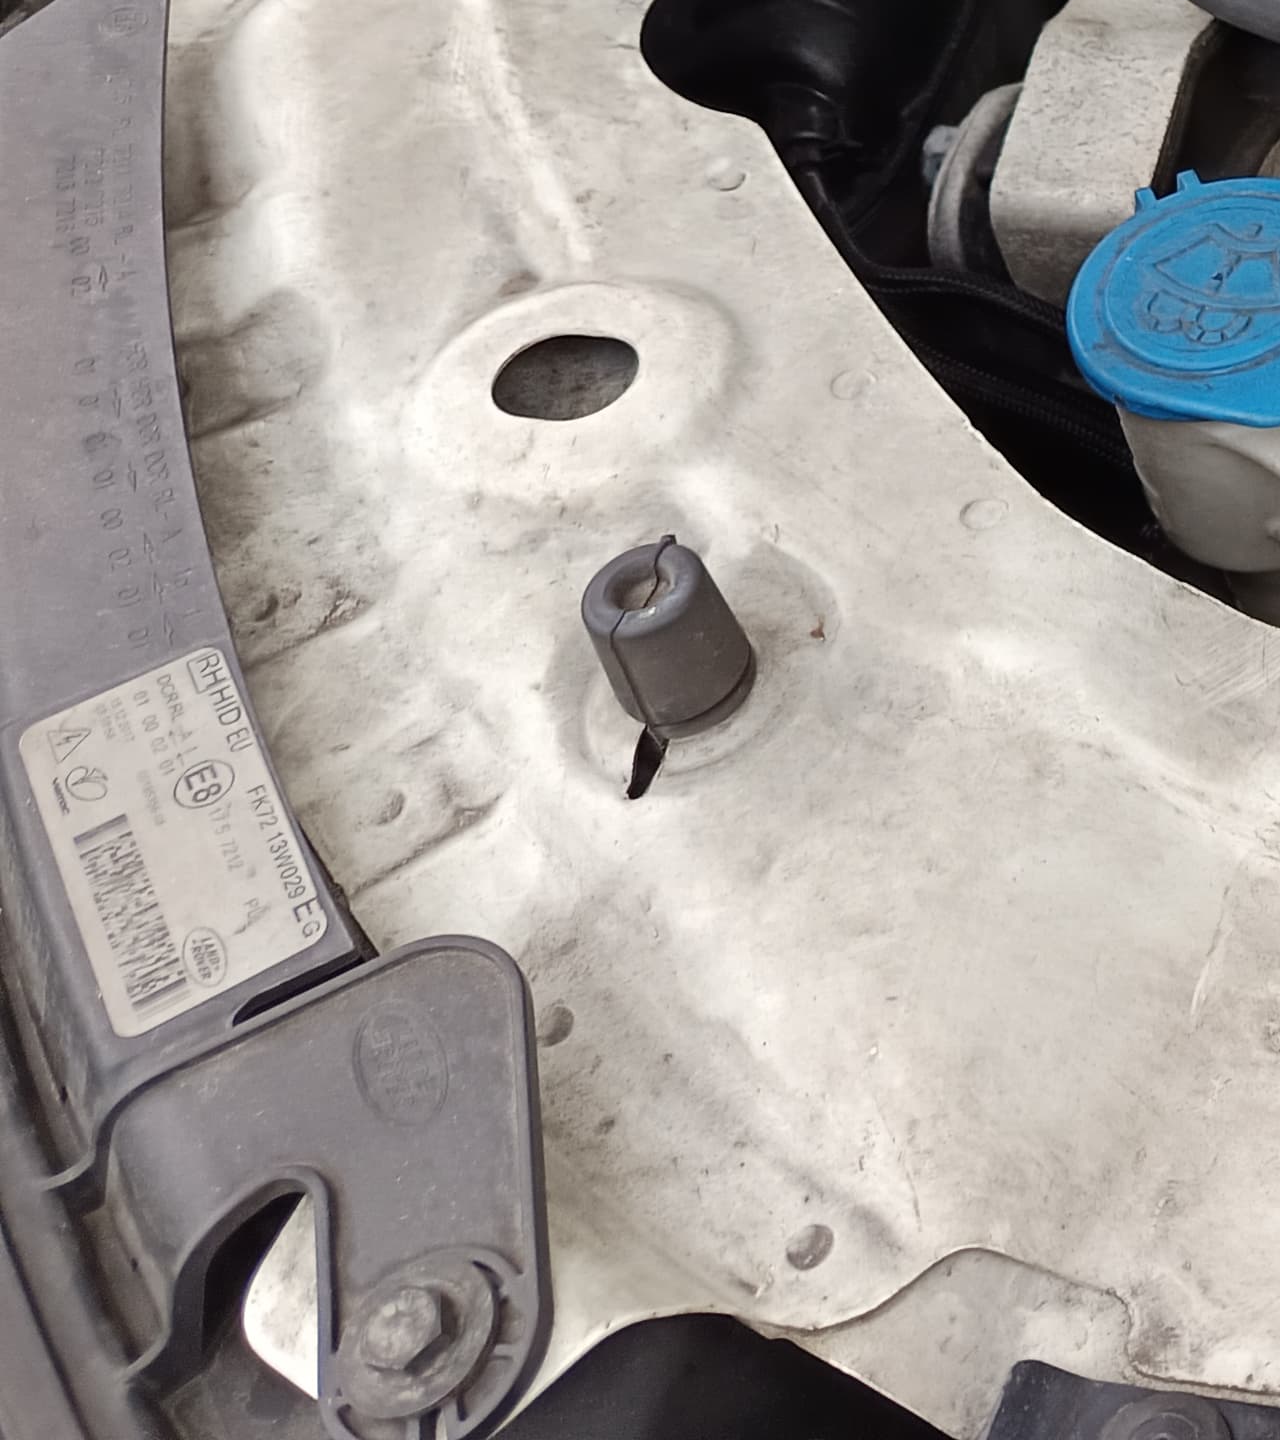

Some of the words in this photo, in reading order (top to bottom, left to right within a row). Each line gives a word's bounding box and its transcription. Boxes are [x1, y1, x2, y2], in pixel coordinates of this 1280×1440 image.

[197, 653, 226, 687] RH
[208, 686, 241, 727] HID
[226, 728, 250, 753] EU
[184, 765, 221, 804] E8
[246, 784, 278, 829] FK72
[266, 831, 308, 899] 13W029
